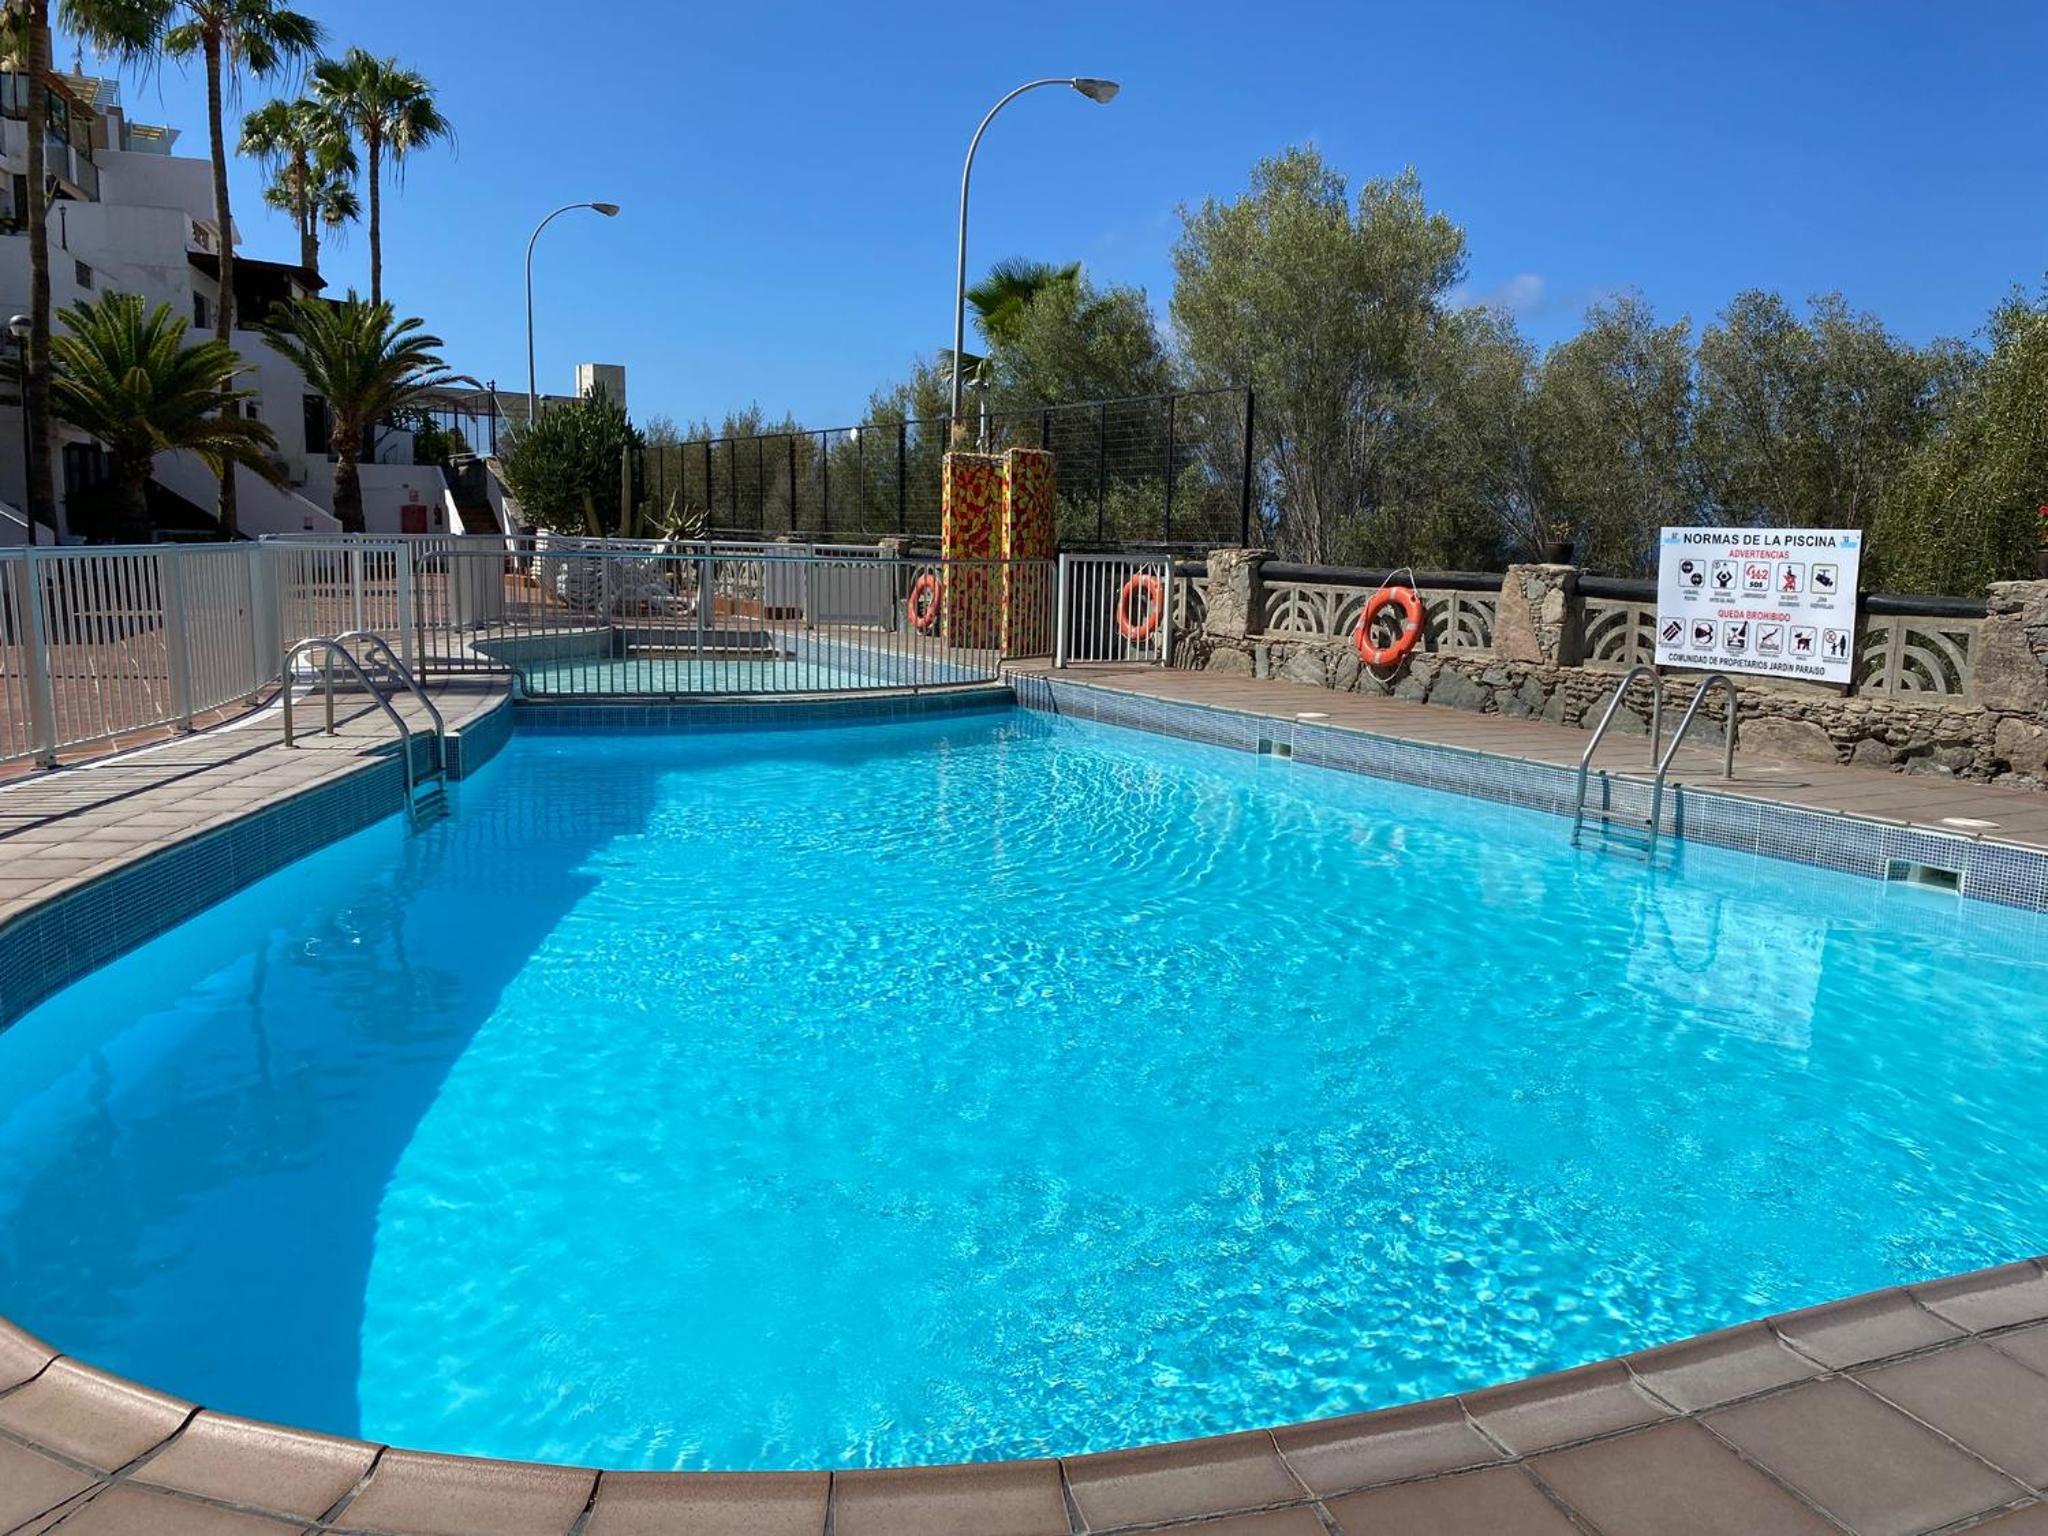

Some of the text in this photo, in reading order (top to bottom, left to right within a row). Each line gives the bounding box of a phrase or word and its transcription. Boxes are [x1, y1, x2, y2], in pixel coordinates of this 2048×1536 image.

[1683, 533, 1836, 547] NORMAS DE LA PISCINA
[1728, 549, 1790, 559] ADVERTENCIAS
[1718, 609, 1791, 621] QUEDA PROHIBIDO
[1668, 653, 1708, 665] COMUNIDAD
[1709, 656, 1718, 665] DE
[1719, 657, 1768, 670] PROPIETARIOS
